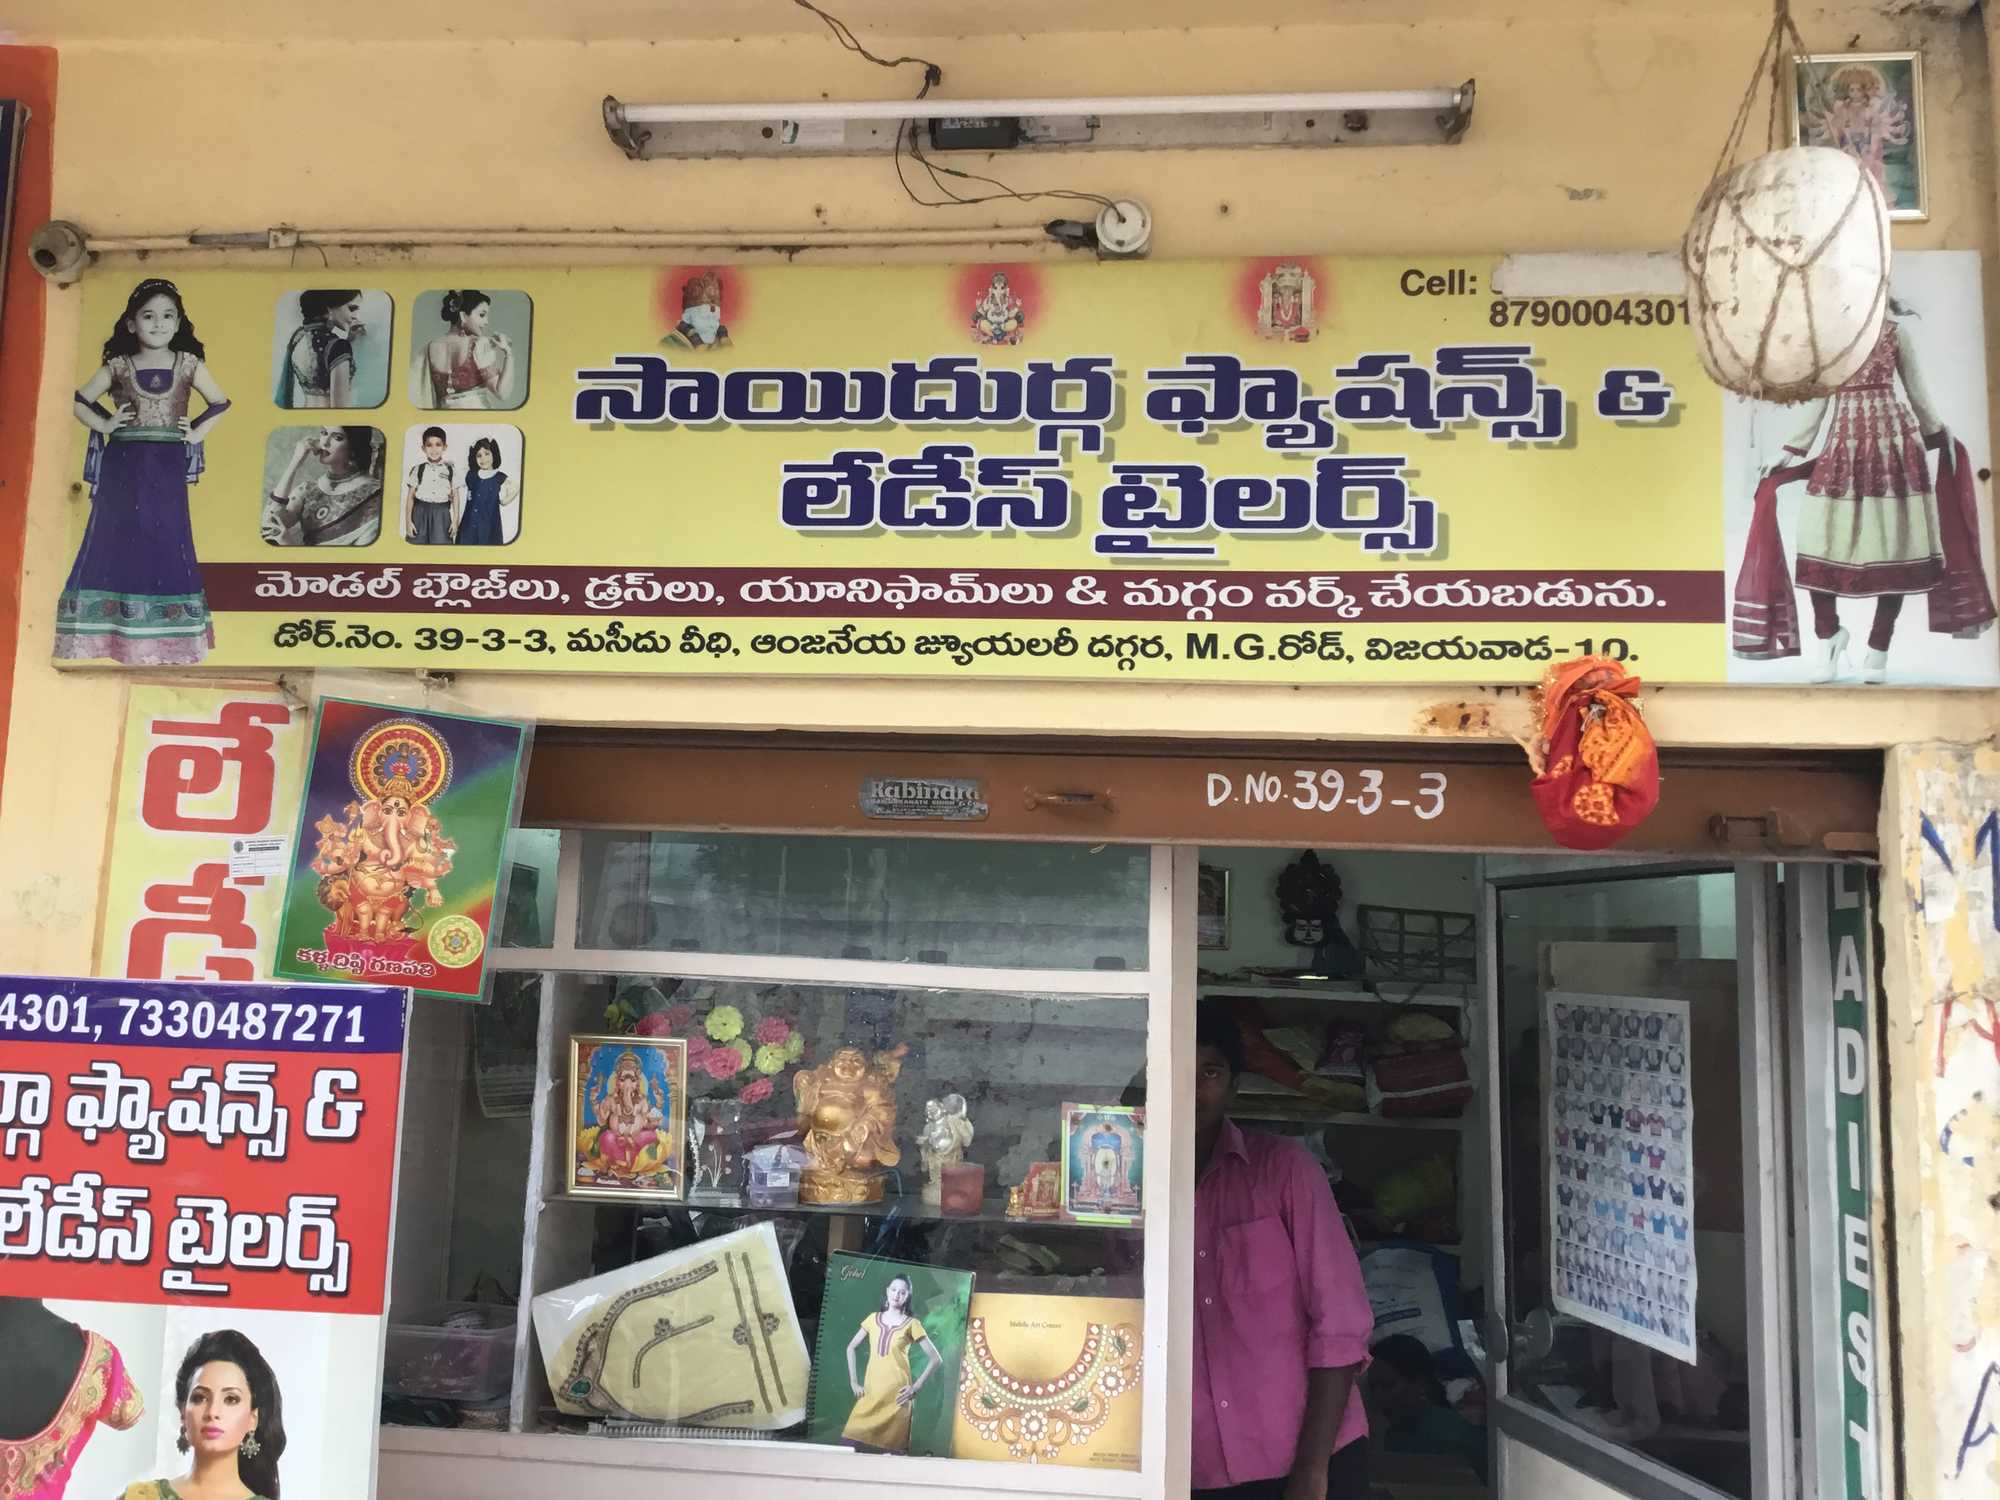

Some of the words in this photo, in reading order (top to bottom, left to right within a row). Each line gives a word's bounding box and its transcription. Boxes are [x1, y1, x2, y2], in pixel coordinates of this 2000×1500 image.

[1401, 269, 1477, 296] Cell:
[1489, 299, 1690, 327] 8790004301
[576, 356, 1111, 453] సాయిదుర్గ
[1147, 348, 1562, 448] ఫ్యాషన్స్
[1599, 372, 1669, 416] &
[782, 445, 1068, 528] లేడీస్
[1095, 457, 1434, 554] టైలర్స్
[255, 569, 402, 600] మోడల్
[1065, 575, 1108, 605] &
[1123, 578, 1254, 620] మగ్గం
[1265, 576, 1362, 618] వర్క్
[1367, 573, 1668, 609] చేయబడును.
[414, 627, 556, 654] 39-3-3,
[566, 621, 671, 654] మసీదు
[679, 625, 741, 657] వీధి,
[750, 624, 906, 655] ఆంజనేయ
[914, 627, 1079, 666] జ్యూయలరీ
[1087, 634, 1174, 671] దగ్గర,
[1186, 631, 1355, 664] M.G.రోడ్,
[1365, 635, 1639, 662] విజయవాడ-10.
[118, 998, 365, 1043] 7330487271
[66, 1062, 290, 1160] ఫ్యాషన్స్
[305, 1069, 364, 1138] &
[0, 1173, 151, 1261] లేడీస్
[163, 1196, 349, 1292] టైలర్స్
